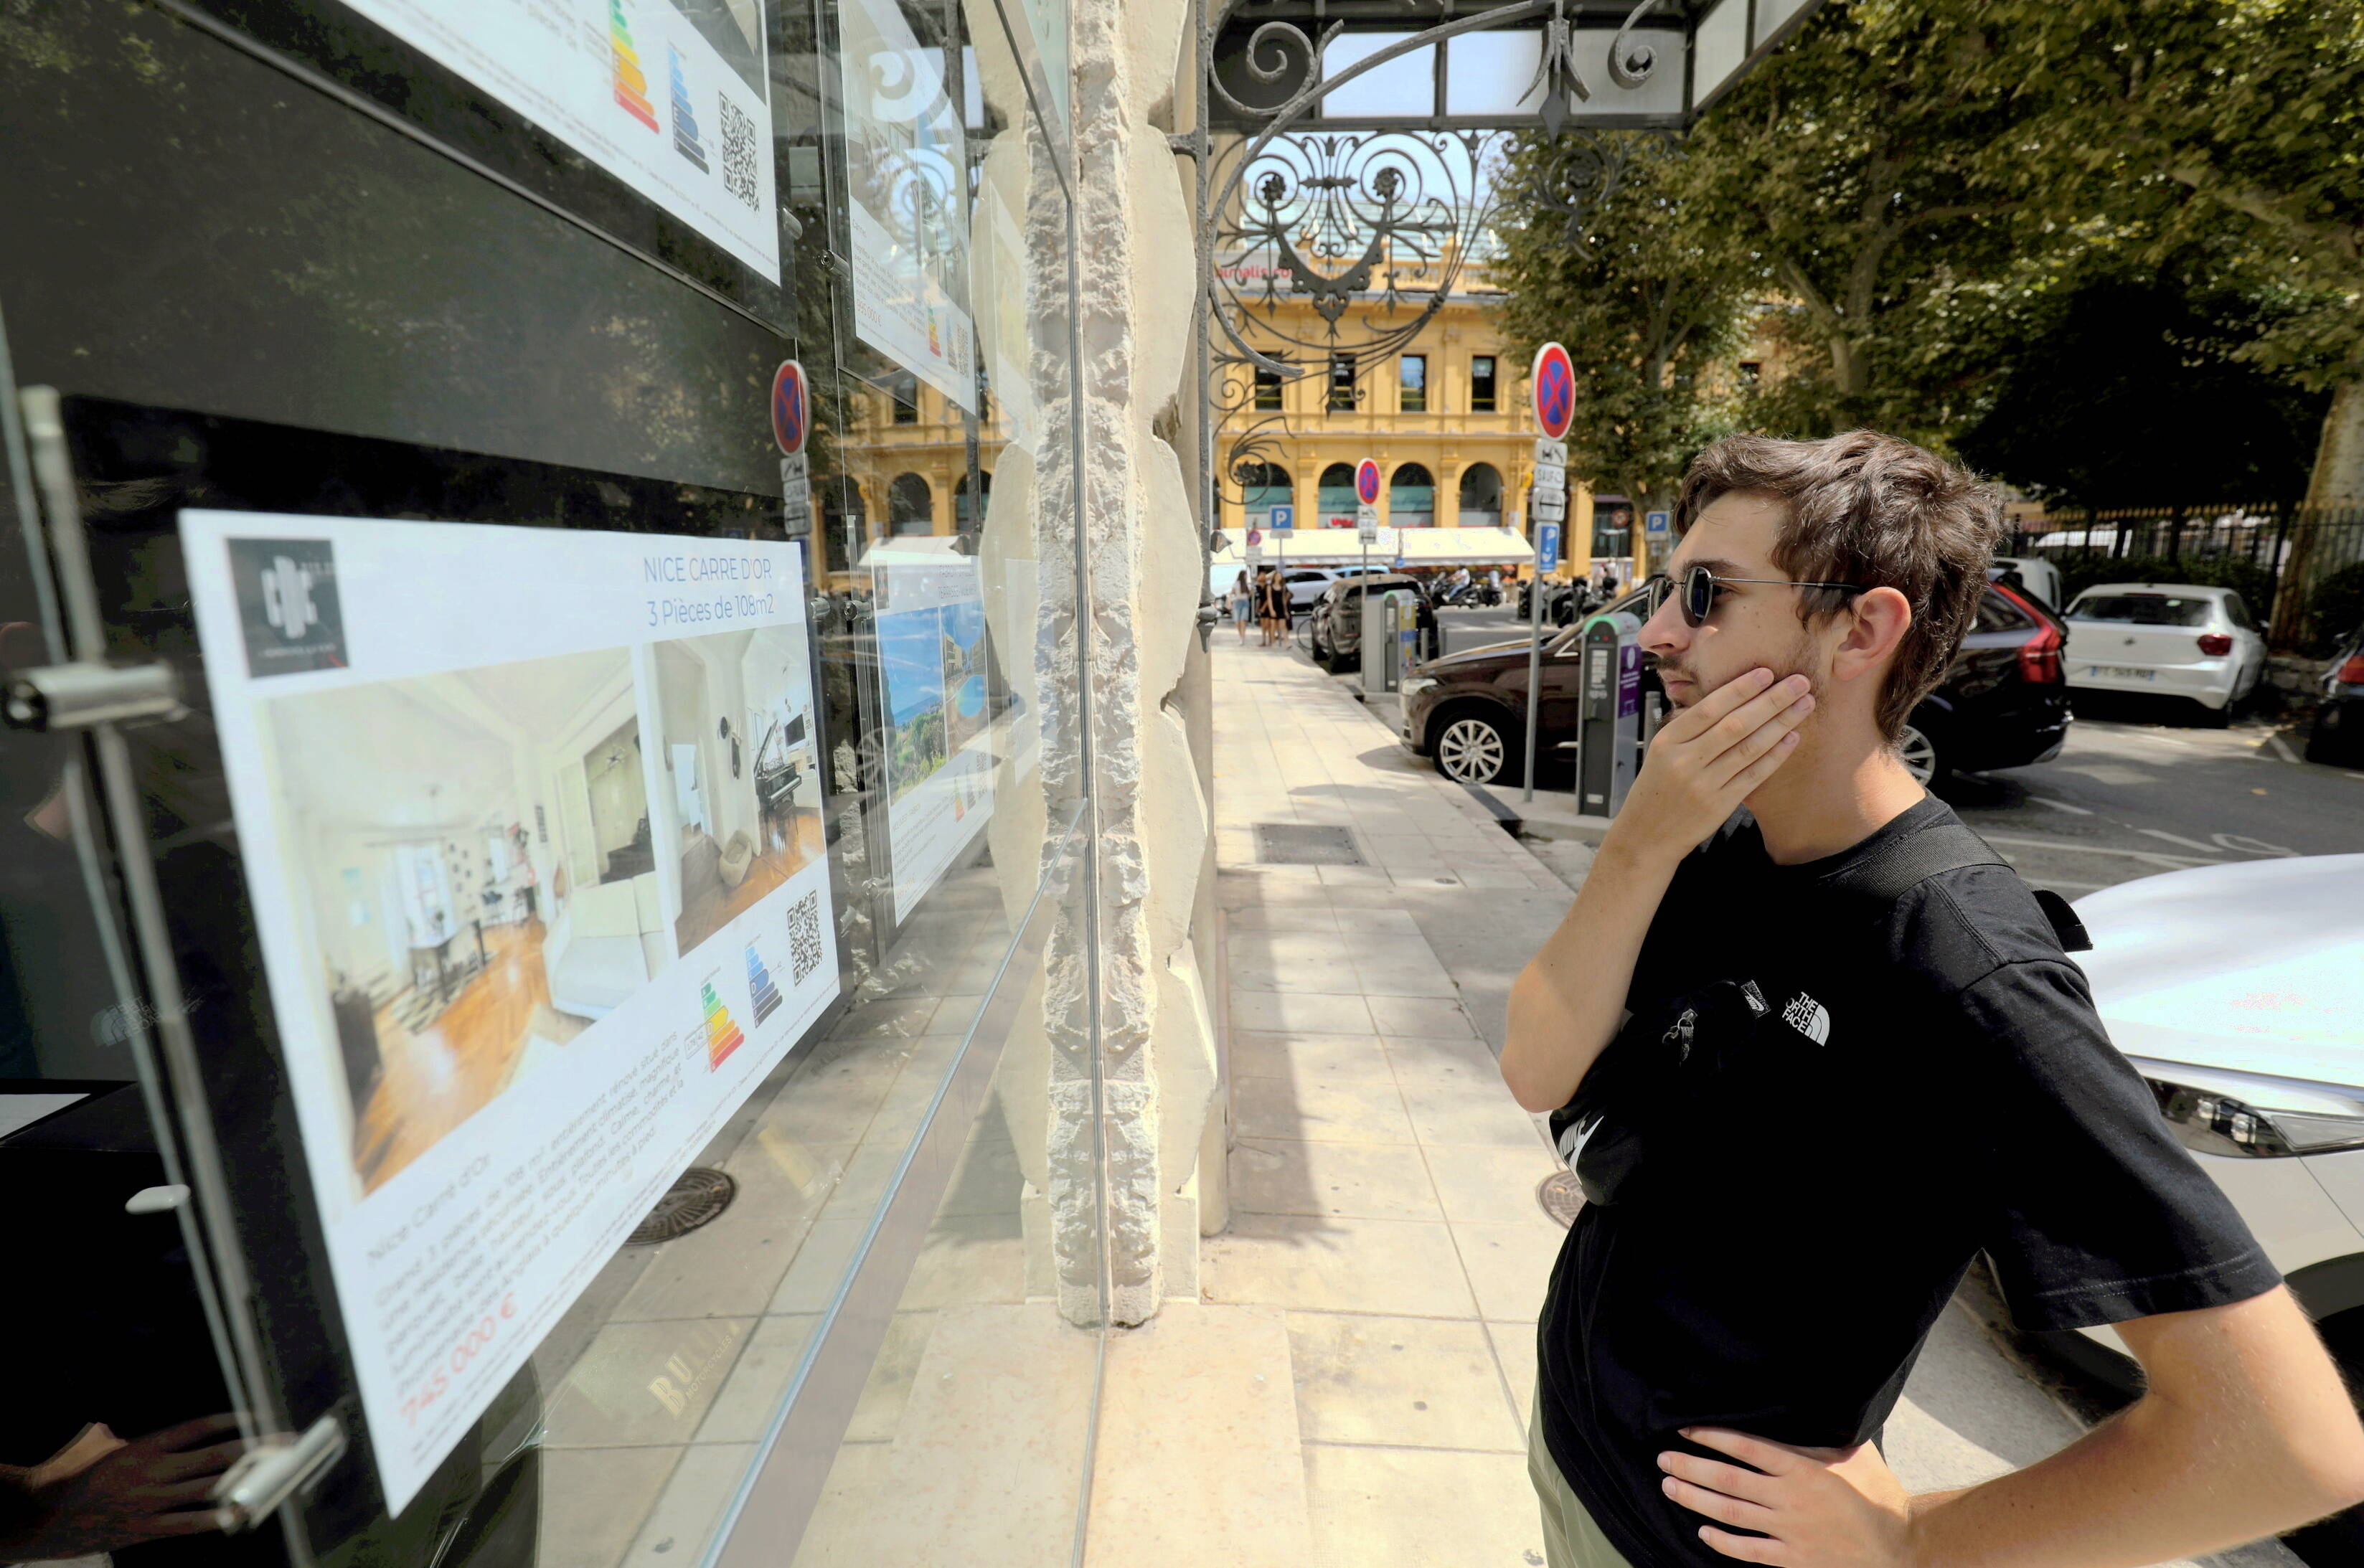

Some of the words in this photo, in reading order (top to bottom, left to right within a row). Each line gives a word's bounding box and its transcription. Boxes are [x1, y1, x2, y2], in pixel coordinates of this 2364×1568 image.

[1276, 510, 1286, 526] P
[644, 557, 686, 582] NICE
[689, 557, 738, 582] CARRE
[740, 557, 772, 580] D'OR
[646, 600, 658, 626] 3
[663, 597, 710, 625] Pièces
[714, 594, 733, 619] de
[735, 592, 775, 617] 108m2
[1786, 997, 1813, 1023] ORTH
[1799, 991, 1819, 1013] THE
[1782, 1008, 1808, 1034] FACE
[685, 1335, 733, 1399] MOTORCYCLES
